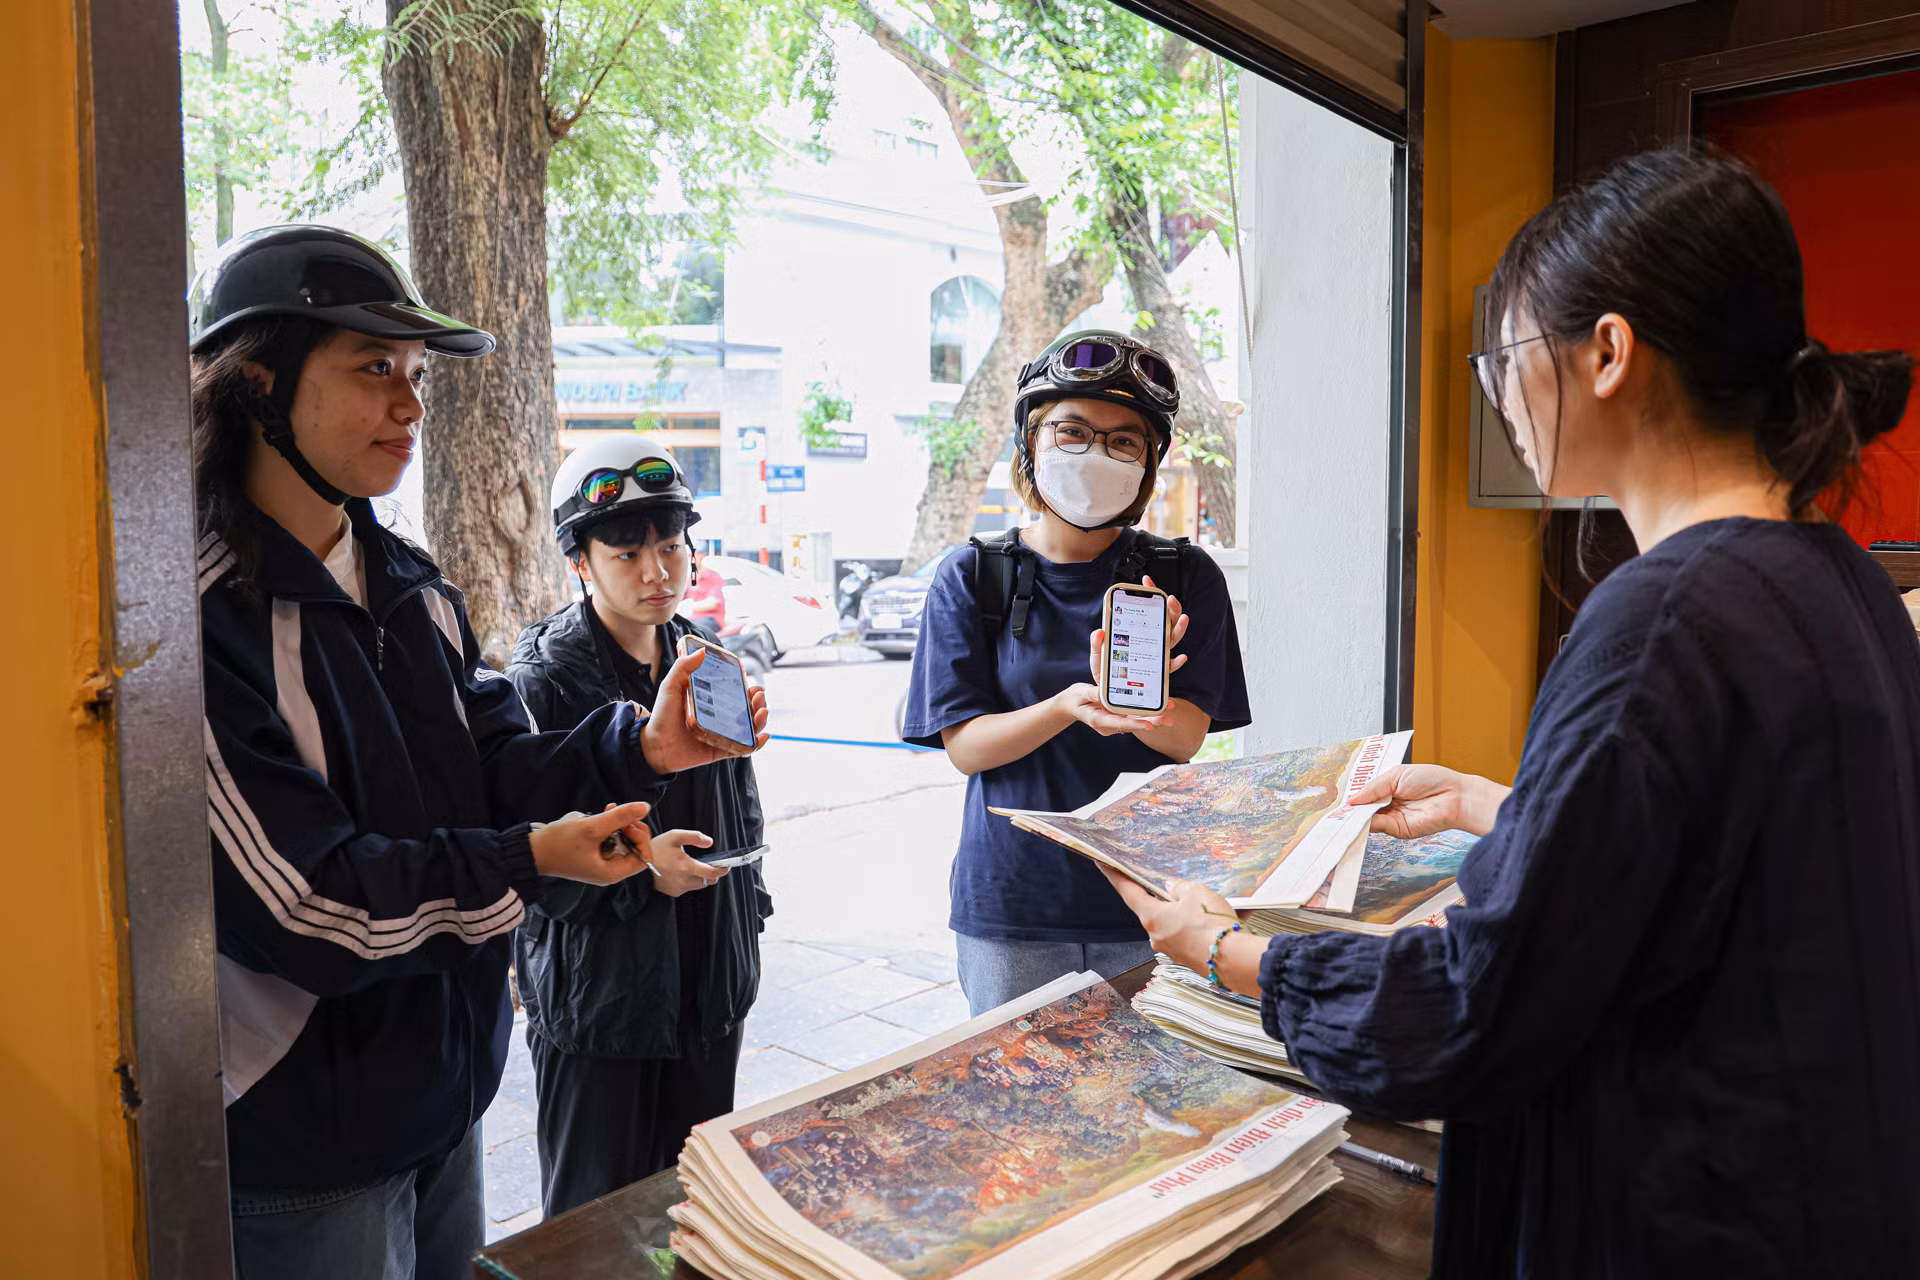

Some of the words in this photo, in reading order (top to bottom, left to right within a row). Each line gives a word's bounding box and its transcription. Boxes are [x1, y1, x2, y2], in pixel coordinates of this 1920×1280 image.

[1261, 1107, 1304, 1129] dịch
[1223, 1127, 1273, 1155] Điện
[1185, 1150, 1236, 1174] Biên
